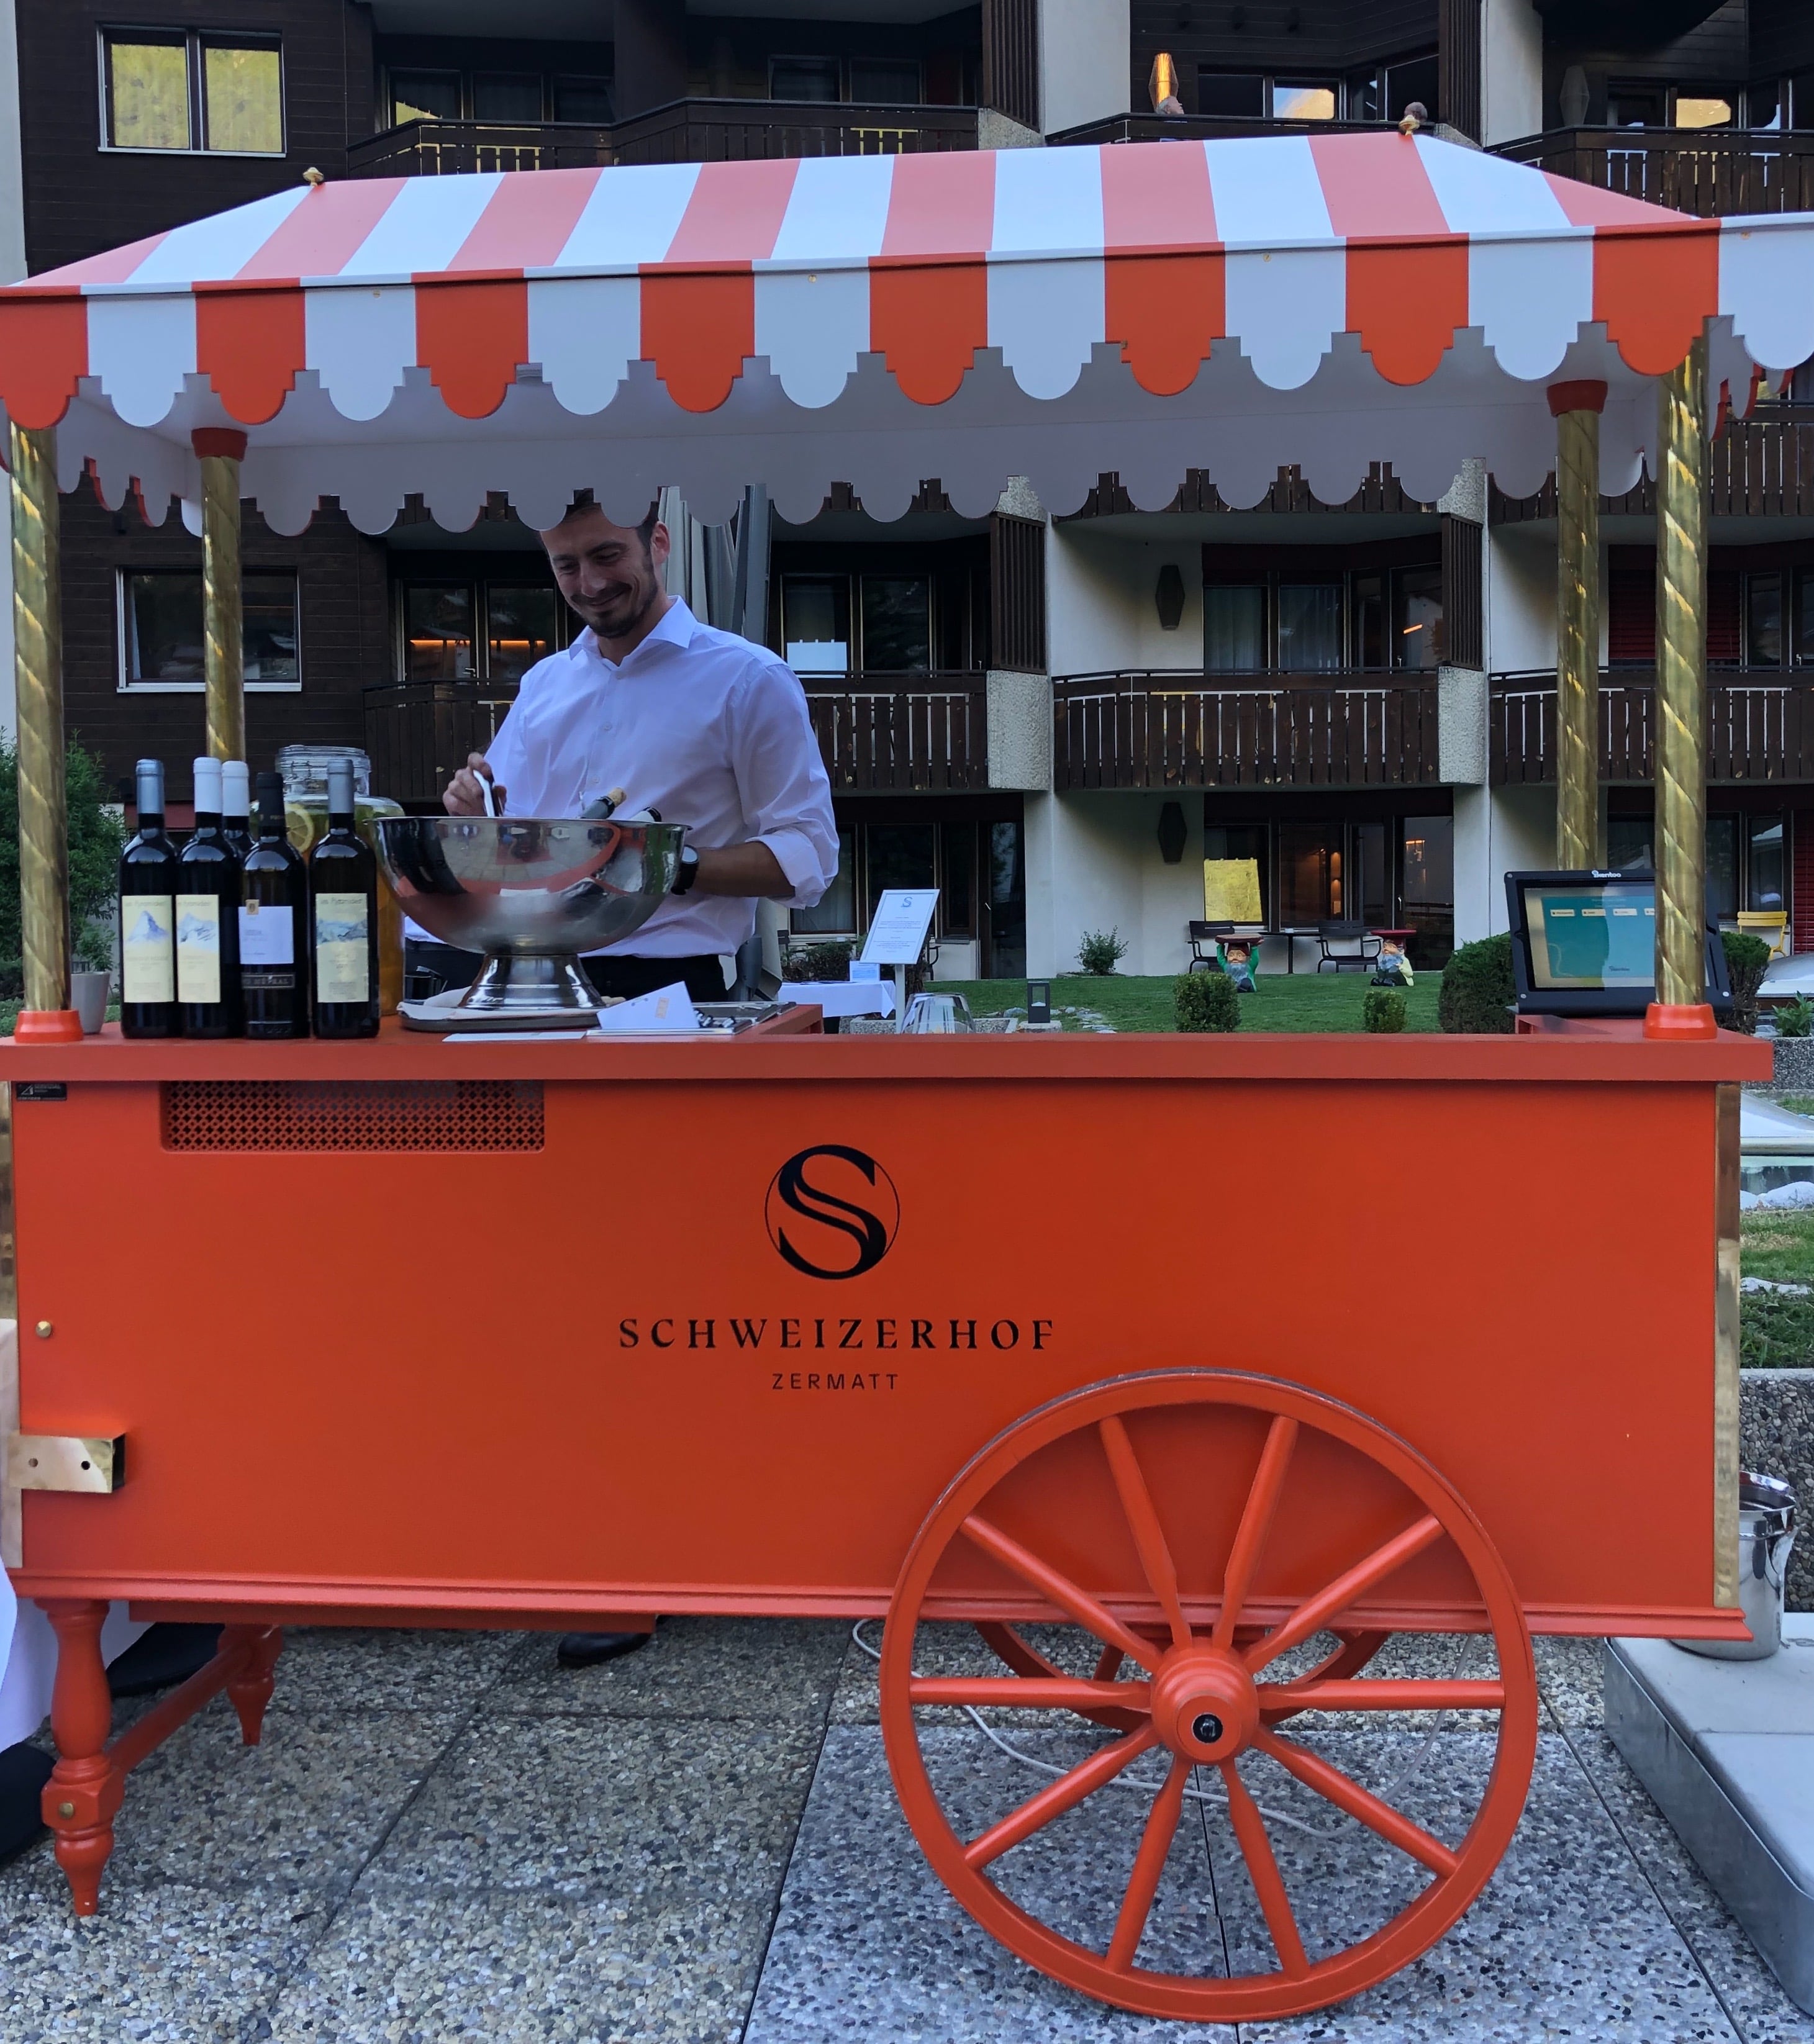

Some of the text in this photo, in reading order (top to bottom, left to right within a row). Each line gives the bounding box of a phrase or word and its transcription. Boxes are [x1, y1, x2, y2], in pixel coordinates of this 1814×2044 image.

[778, 1144, 887, 1280] S
[620, 1319, 1052, 1349] SCHWEIZERHOF
[773, 1373, 897, 1389] ZERMATT
